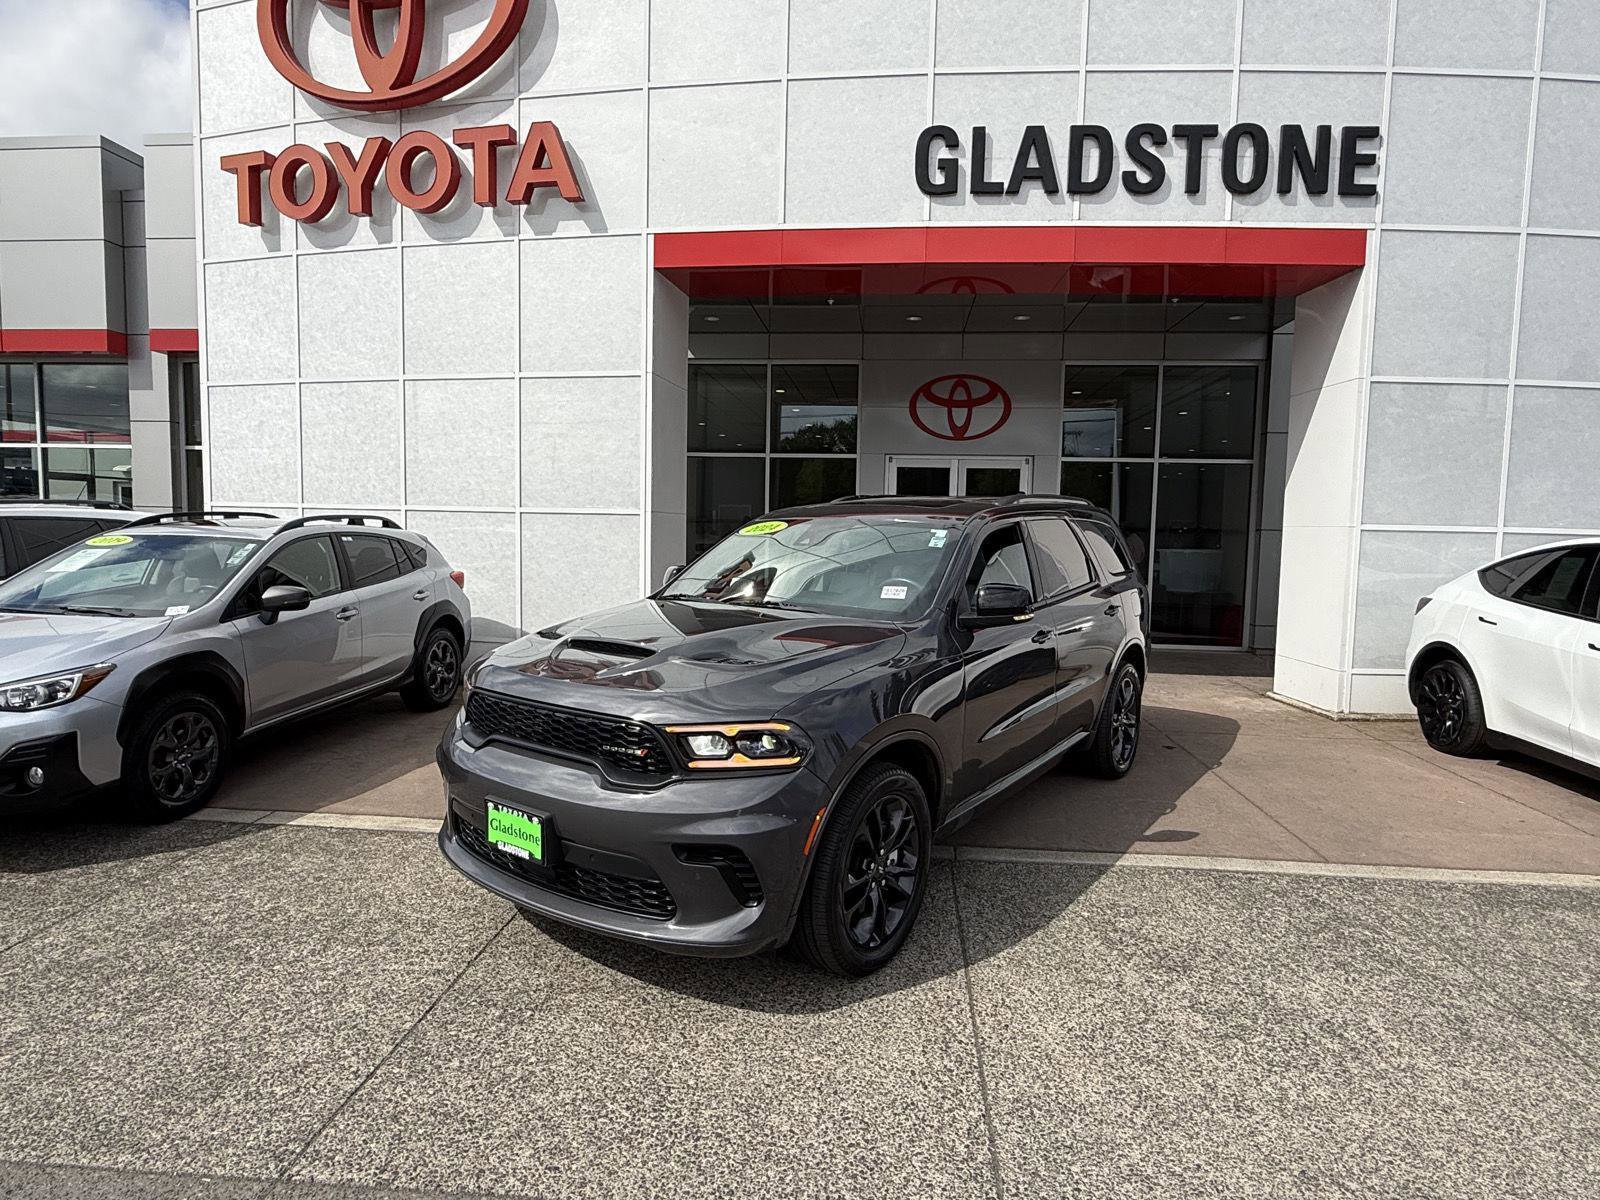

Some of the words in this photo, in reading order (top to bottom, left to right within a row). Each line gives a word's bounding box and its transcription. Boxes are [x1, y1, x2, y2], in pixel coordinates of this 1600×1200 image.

[220, 120, 585, 228] TOYOTA
[914, 122, 1380, 197] GLADSTONE
[489, 818, 541, 846] Gladstone
[498, 804, 529, 820] TOYOTA
